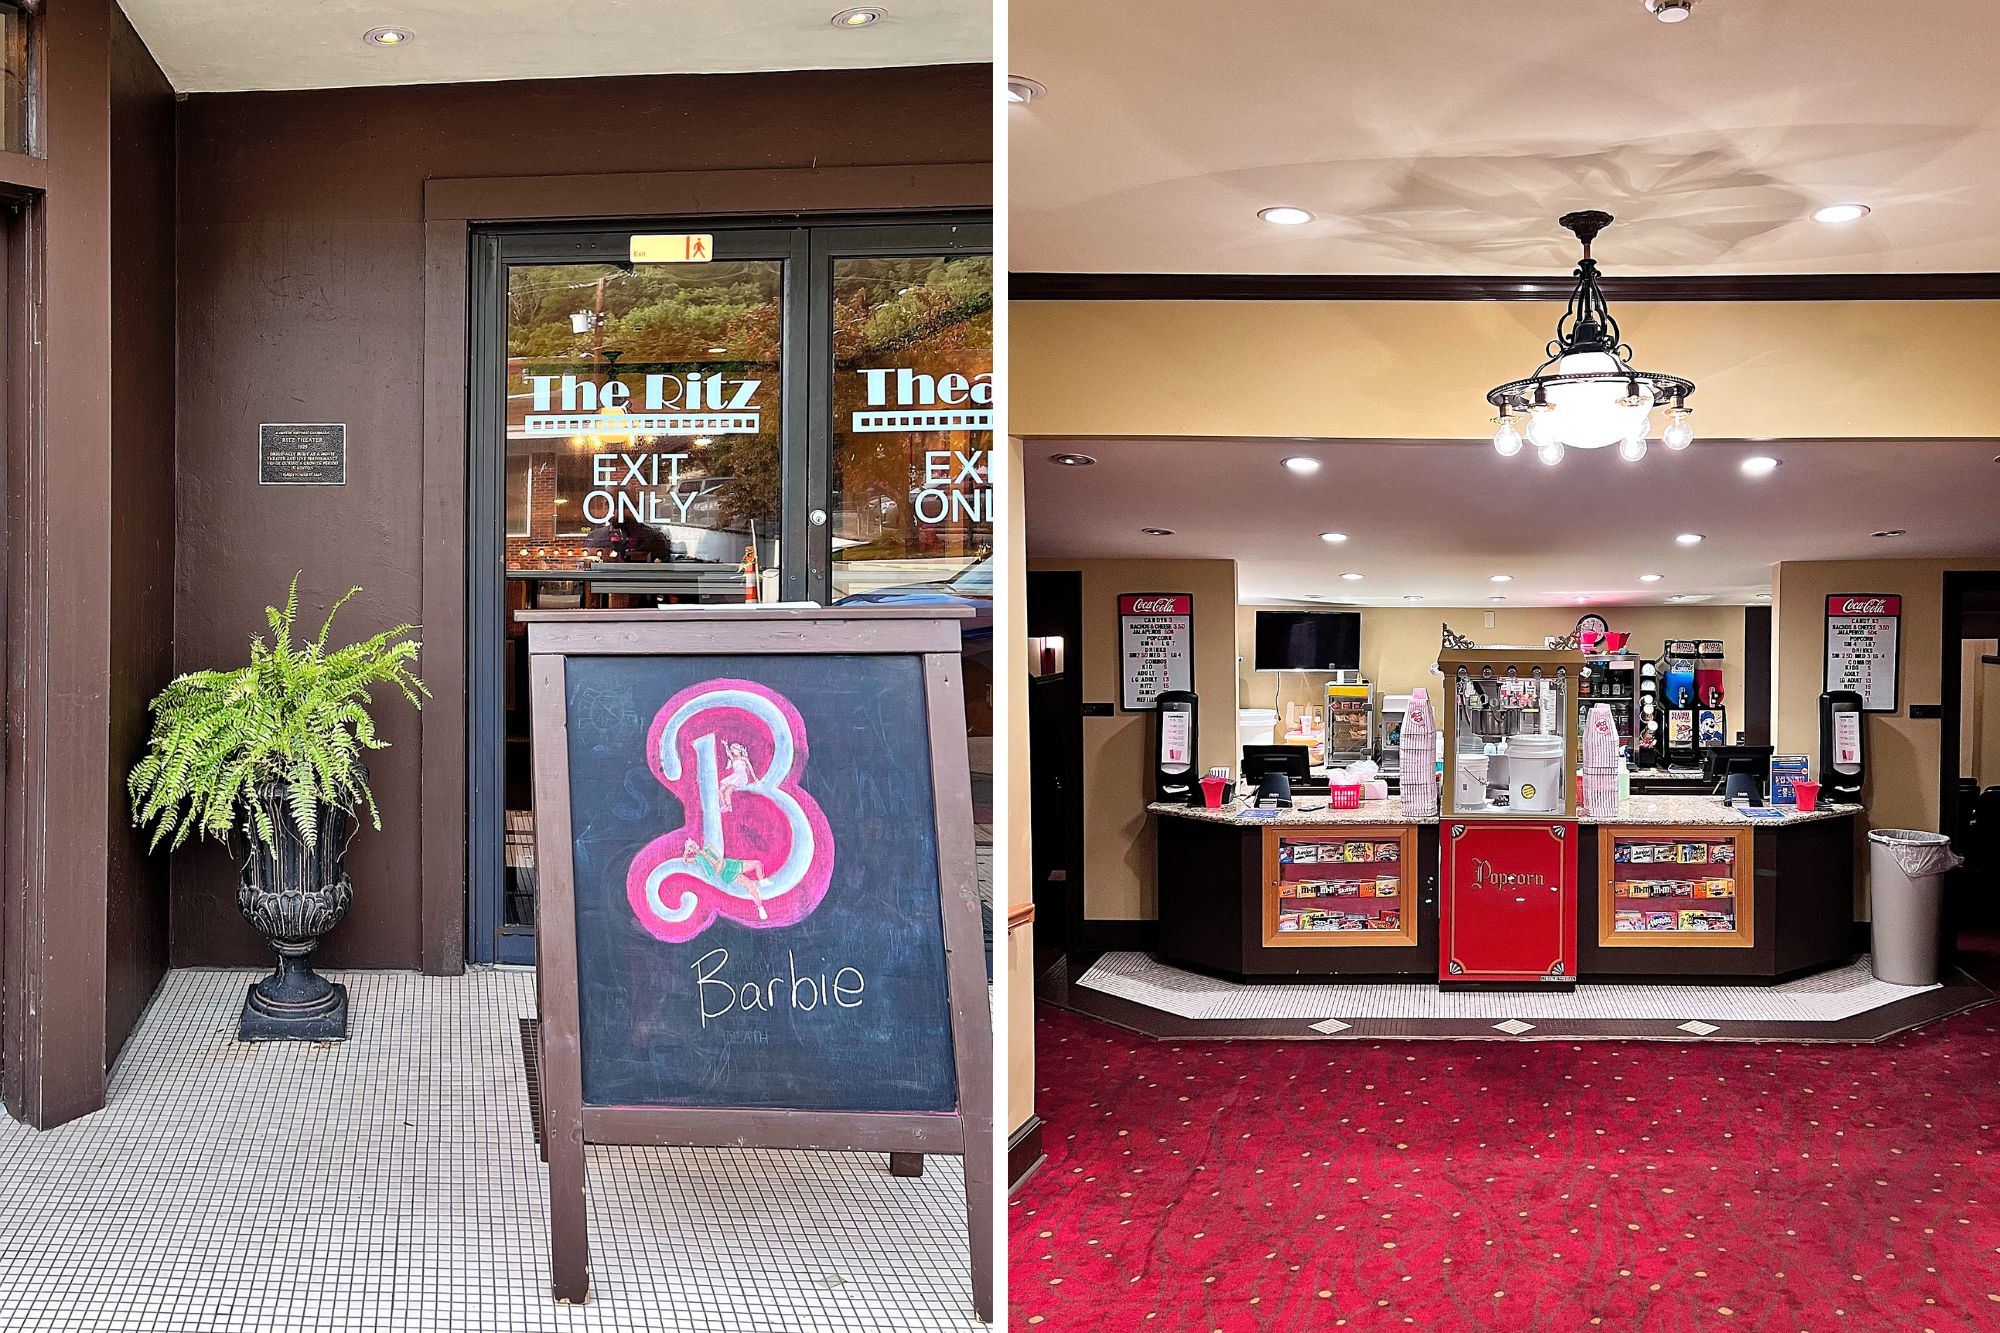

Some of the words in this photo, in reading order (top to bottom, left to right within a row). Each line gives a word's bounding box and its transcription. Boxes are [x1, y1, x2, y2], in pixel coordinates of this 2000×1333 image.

[524, 373, 630, 411] The
[646, 373, 761, 411] Ritz
[593, 454, 688, 486] EXIT
[582, 490, 698, 524] ONLY
[1133, 598, 1176, 612] Coca-Cola
[1843, 599, 1886, 613] Coca-Cola
[1471, 858, 1544, 890] Popcorn
[690, 948, 866, 1028] Barbie
